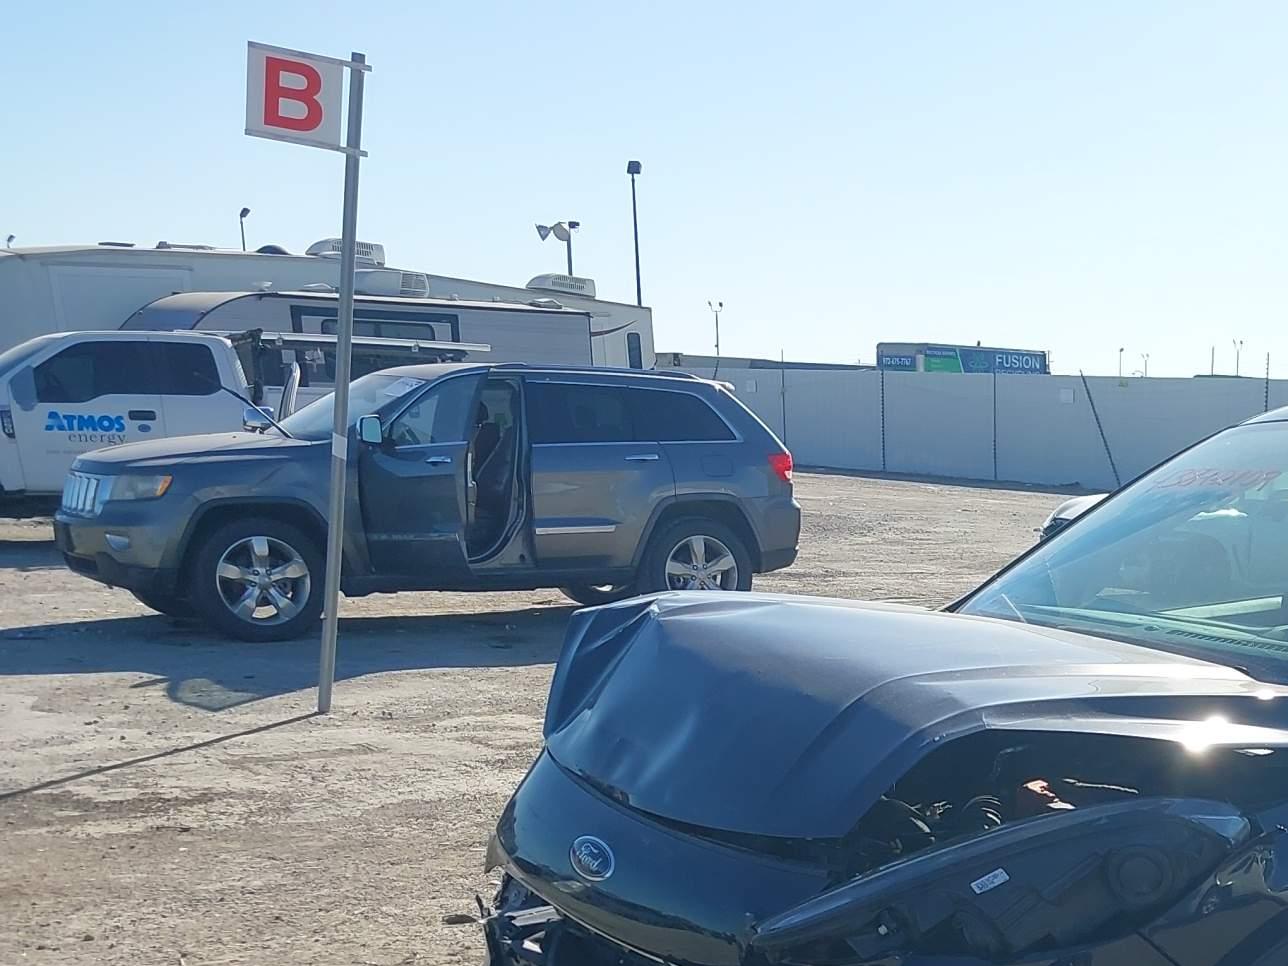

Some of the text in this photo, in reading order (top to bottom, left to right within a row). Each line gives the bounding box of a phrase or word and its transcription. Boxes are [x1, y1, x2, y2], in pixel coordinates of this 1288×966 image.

[263, 56, 324, 132] B
[995, 354, 1040, 369] FUSION
[45, 411, 126, 433] ATMOS
[68, 433, 126, 446] energy
